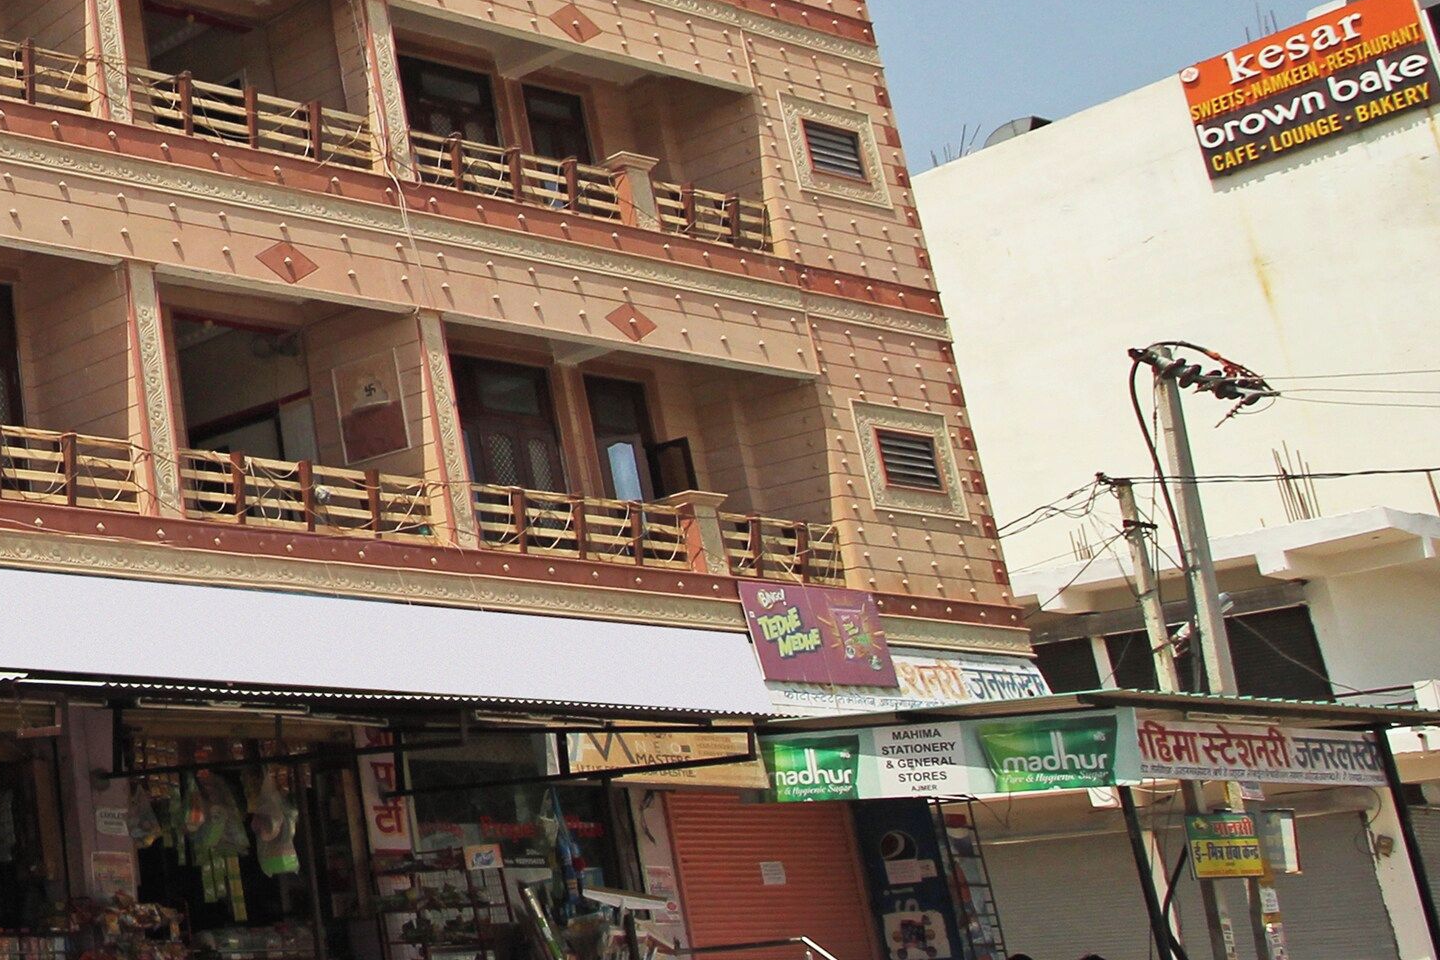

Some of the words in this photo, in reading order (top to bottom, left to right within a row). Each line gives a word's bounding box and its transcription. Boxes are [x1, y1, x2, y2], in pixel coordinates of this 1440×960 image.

[1221, 11, 1362, 85] kesar
[1190, 87, 1247, 122] SWEETS
[1250, 61, 1321, 100] NAMKEEN
[1326, 22, 1421, 72] RESTAURANT
[1196, 89, 1326, 149] brown
[1327, 53, 1429, 102] bake
[1211, 141, 1259, 173] CAFE
[1269, 112, 1342, 153] LOUNGE
[1355, 80, 1431, 123] BAKERY
[757, 607, 802, 640] TEDHE
[777, 626, 823, 658] MEDHE
[881, 741, 957, 756] STATIONERY
[891, 728, 942, 741] MAHIMA
[885, 759, 895, 770] &
[897, 756, 957, 769] GENERAL
[1002, 730, 1108, 773] madhur
[898, 771, 948, 783] STORES
[910, 784, 938, 792] AJMER
